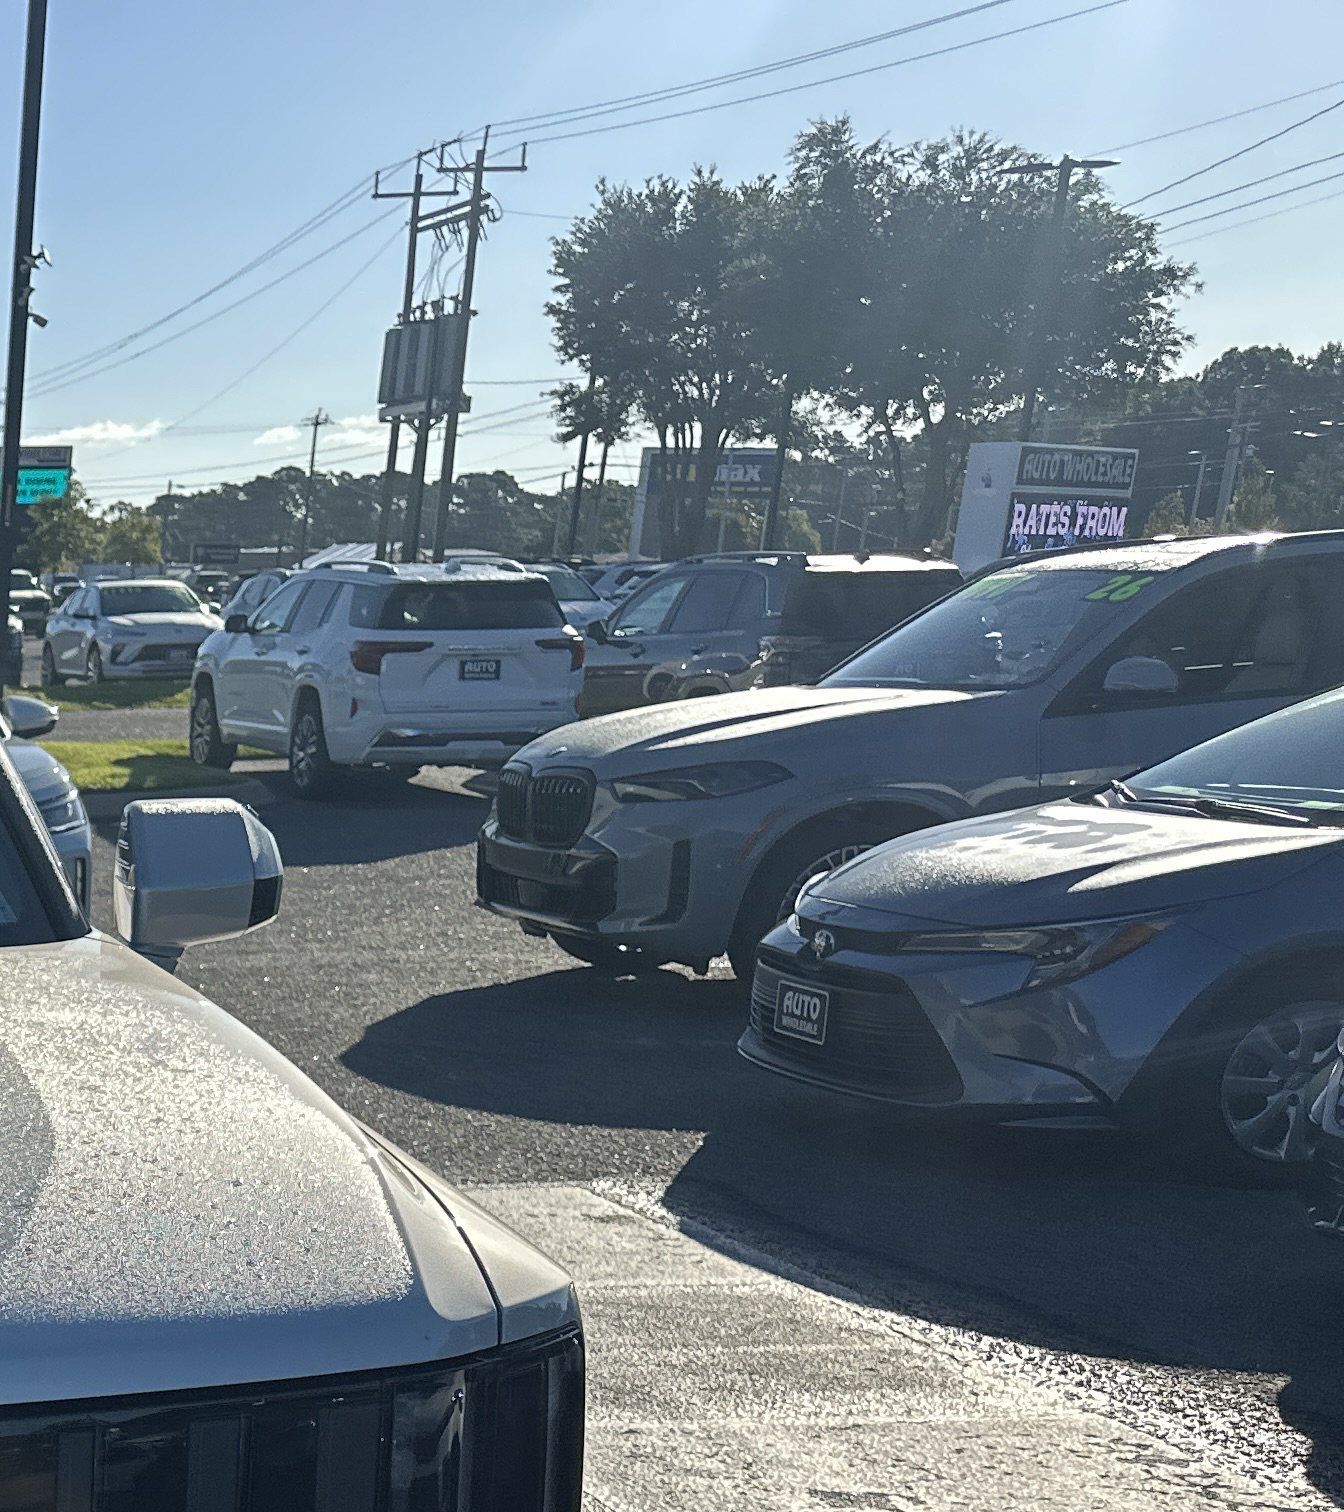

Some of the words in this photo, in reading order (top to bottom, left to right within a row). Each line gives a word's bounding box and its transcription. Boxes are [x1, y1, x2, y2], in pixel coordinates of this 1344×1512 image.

[1022, 452, 1061, 480] AUTO
[1063, 453, 1133, 484] WHOLESALE
[1012, 503, 1072, 536] RATES
[1073, 505, 1128, 538] FROM
[1085, 574, 1155, 602] 26
[464, 661, 497, 673] AUTO
[783, 990, 821, 1021] AUTO
